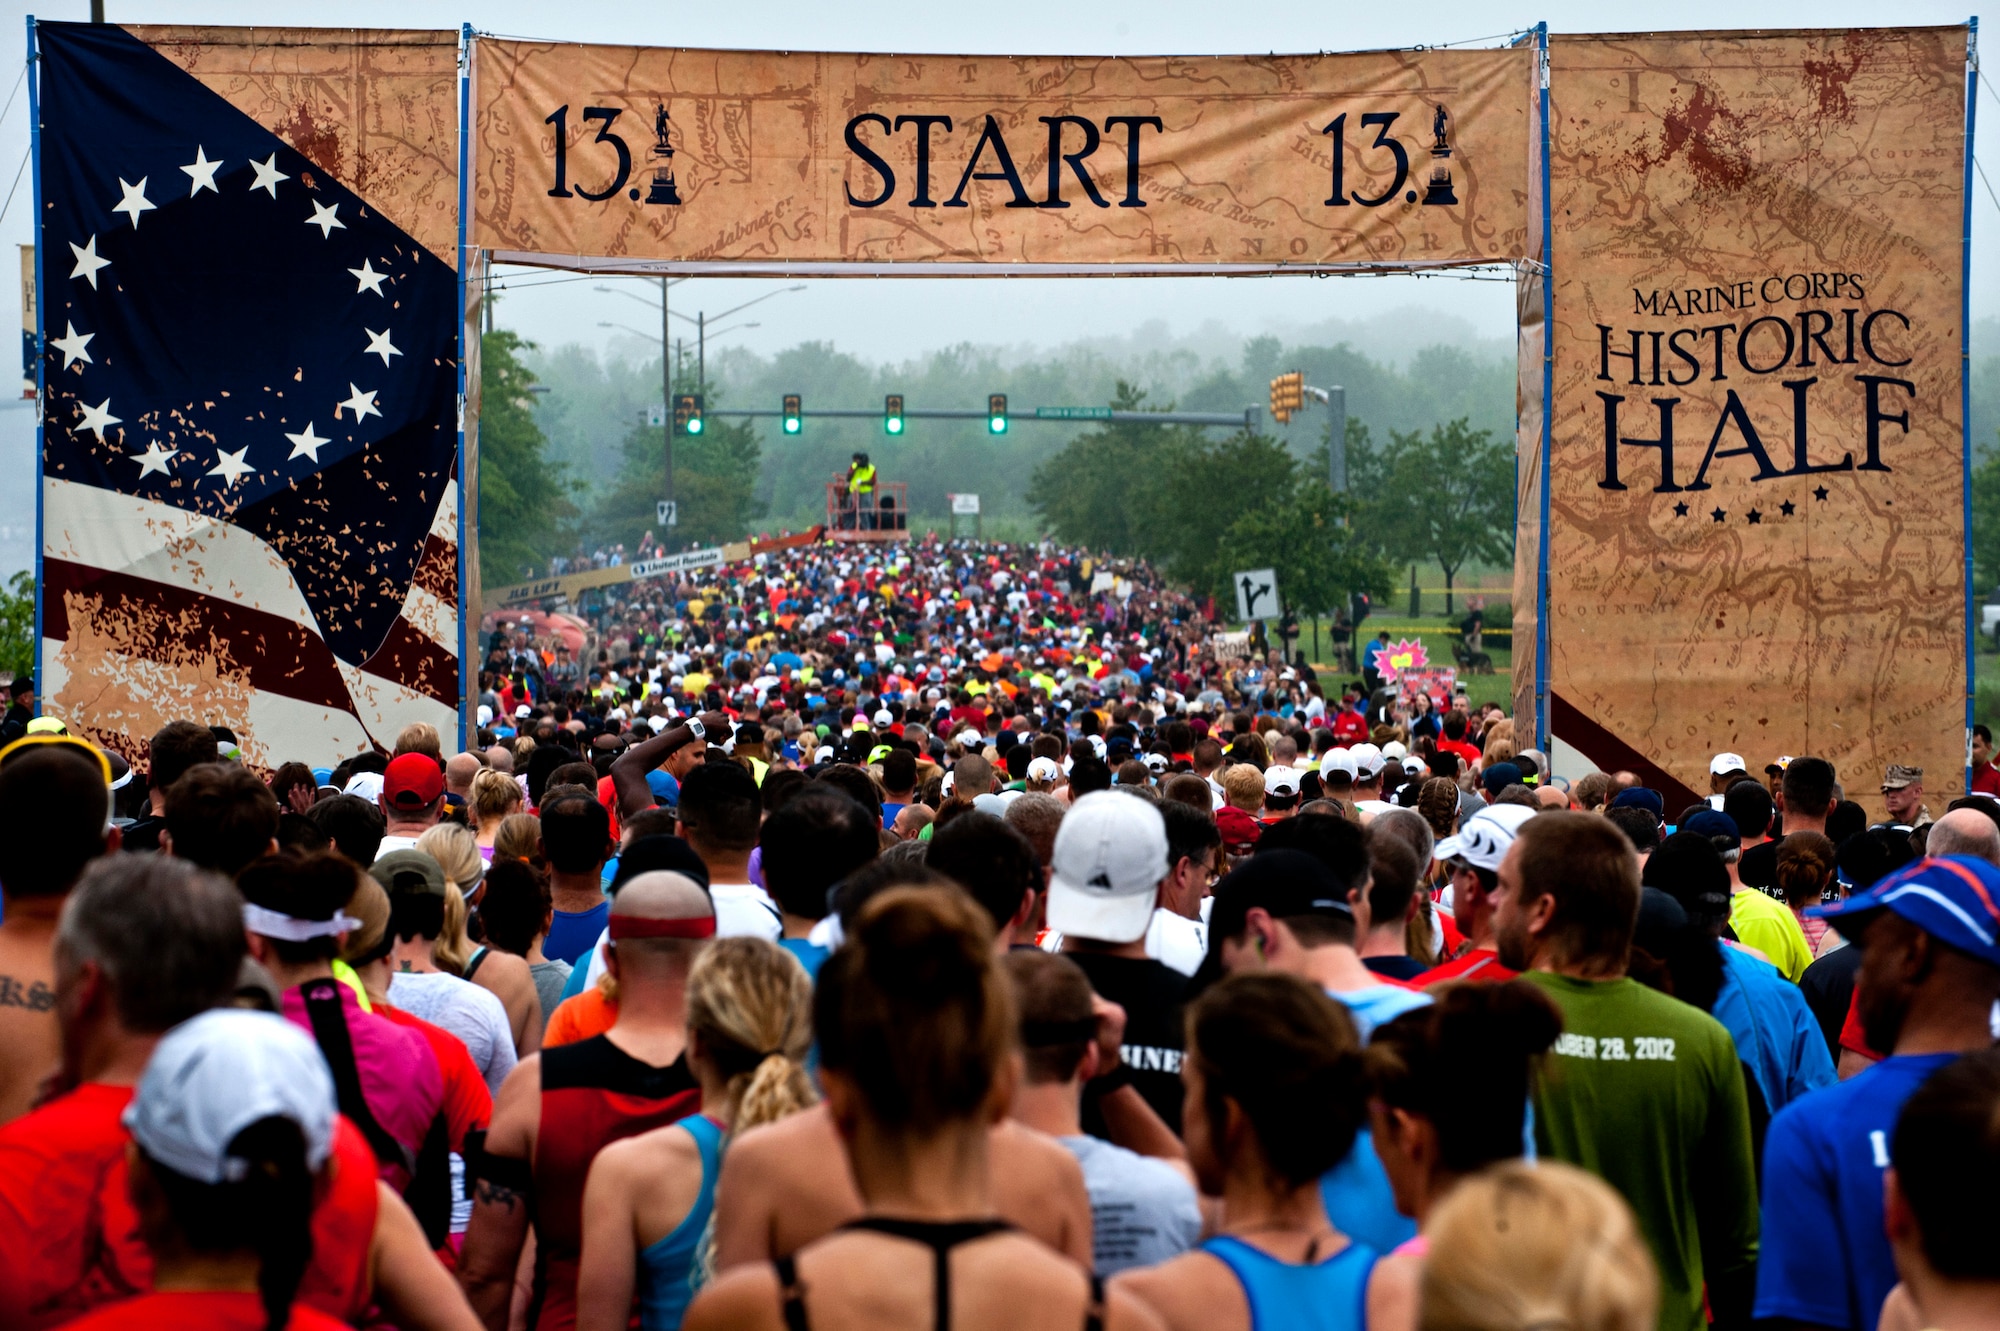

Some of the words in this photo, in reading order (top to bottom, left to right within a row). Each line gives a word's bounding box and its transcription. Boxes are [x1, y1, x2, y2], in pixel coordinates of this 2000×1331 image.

[844, 113, 1163, 208] START
[1148, 232, 1443, 256] HANOVER
[1902, 235, 1952, 286] COUNTY
[1633, 282, 1756, 316] MARINE
[1761, 272, 1865, 304] CORPS
[1596, 308, 1913, 386] HISTORIC
[1595, 375, 1916, 492] HALF
[647, 557, 680, 573] United
[682, 551, 718, 567] Rentals
[1600, 1037, 1631, 1061] 28,
[1633, 1037, 1676, 1061] 2012
